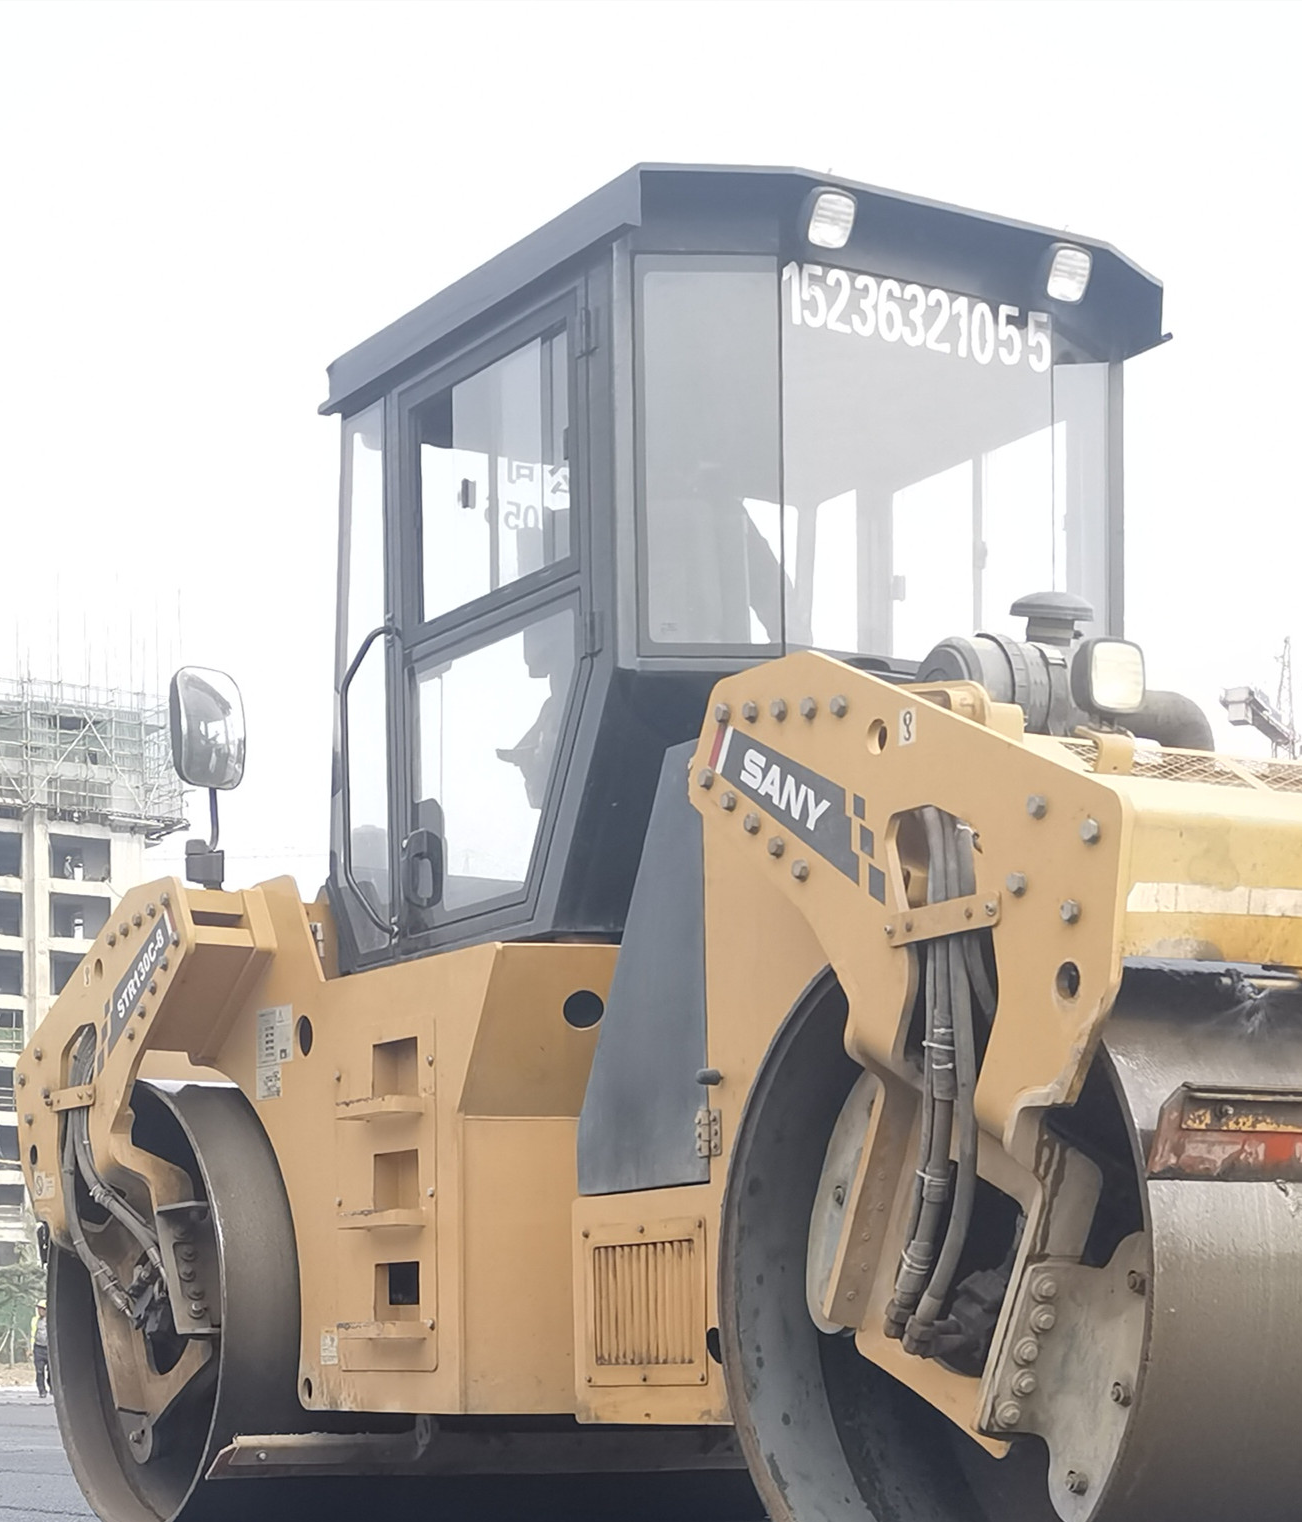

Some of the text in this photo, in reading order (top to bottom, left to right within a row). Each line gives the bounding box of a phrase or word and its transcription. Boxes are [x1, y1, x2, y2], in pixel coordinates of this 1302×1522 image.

[782, 261, 1051, 372] 15236321055
[740, 748, 831, 831] SANY
[117, 928, 164, 1018] STR130C-8
